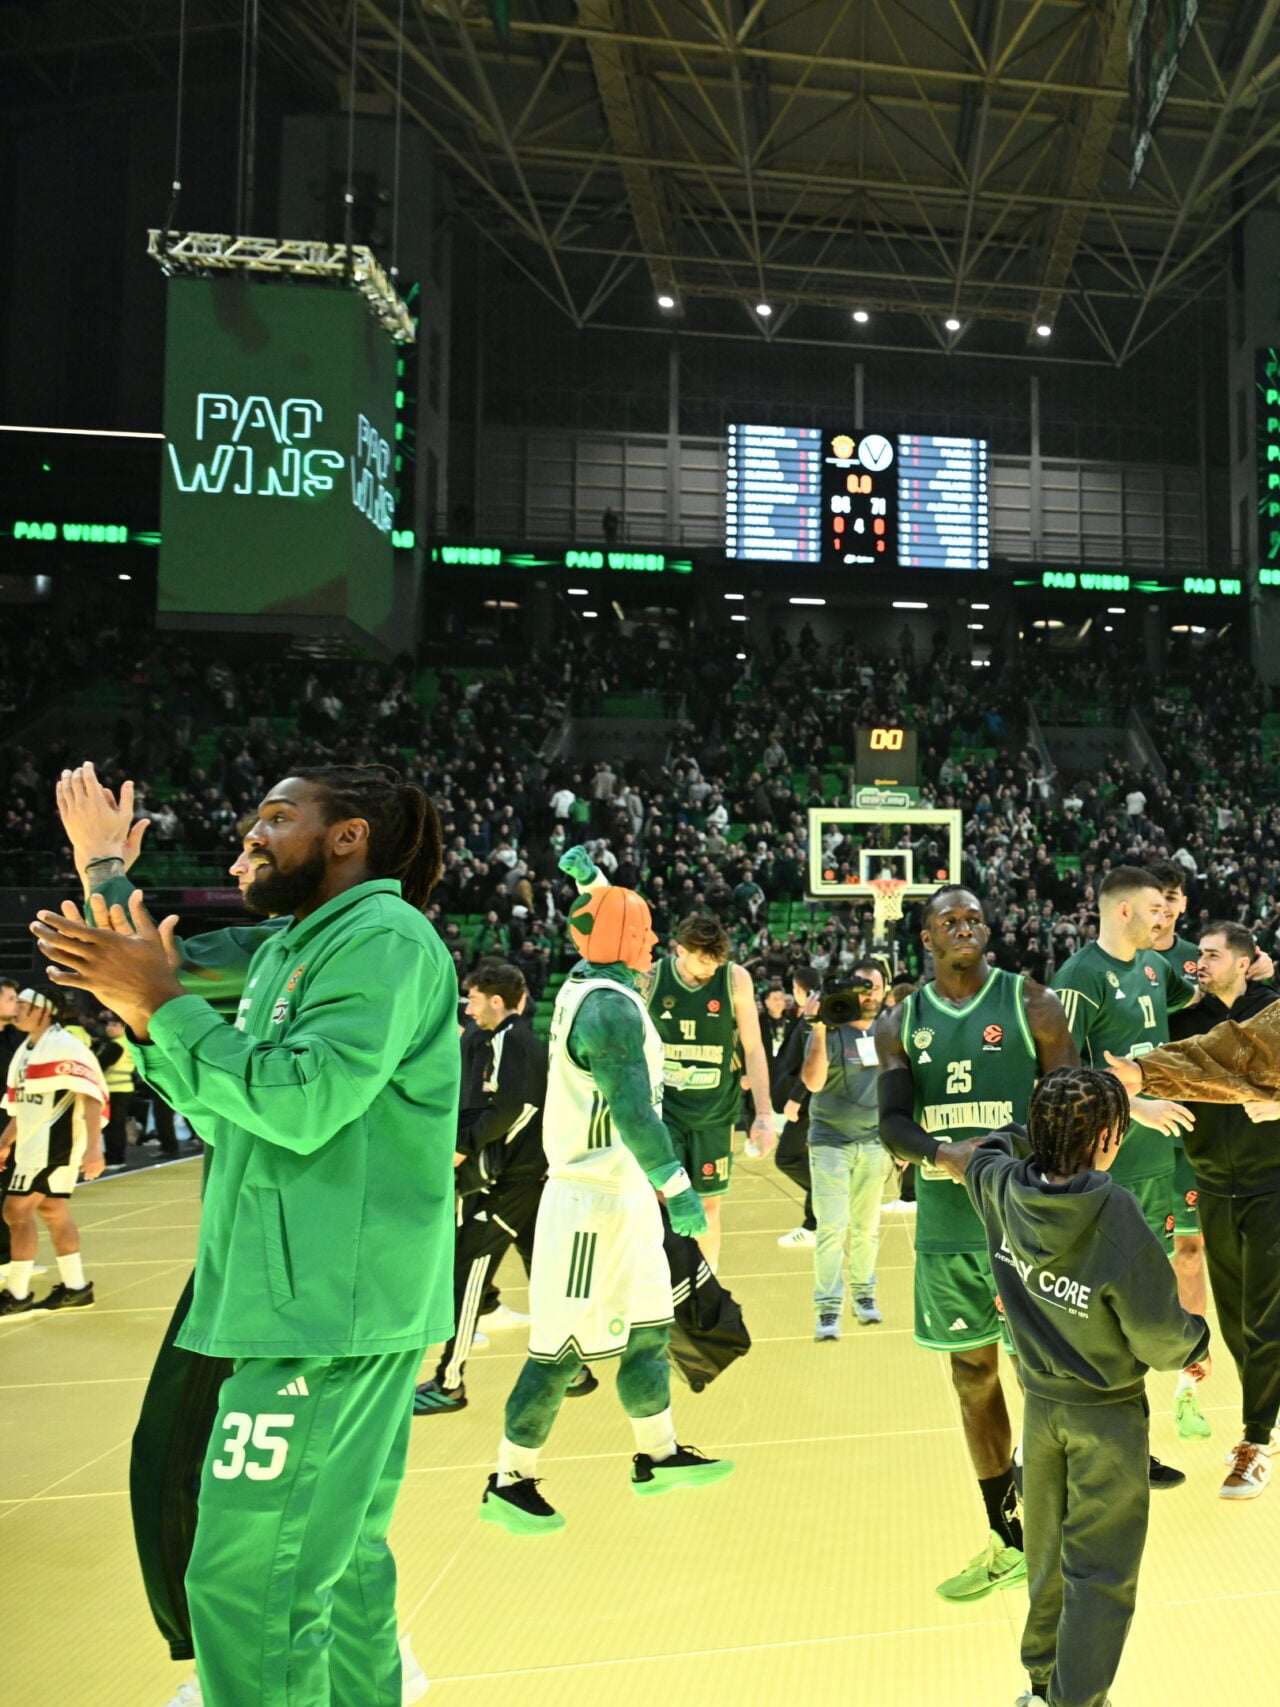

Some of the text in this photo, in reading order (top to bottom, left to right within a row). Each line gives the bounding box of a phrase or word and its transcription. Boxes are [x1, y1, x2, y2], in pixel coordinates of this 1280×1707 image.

[168, 442, 345, 497] WINS
[870, 728, 904, 750] 00
[679, 1019, 697, 1040] 41
[946, 1059, 972, 1094] 25
[11, 1174, 26, 1190] 11
[715, 1157, 729, 1181] 41
[1039, 1271, 1092, 1309] CORE
[212, 1411, 295, 1480] 35
